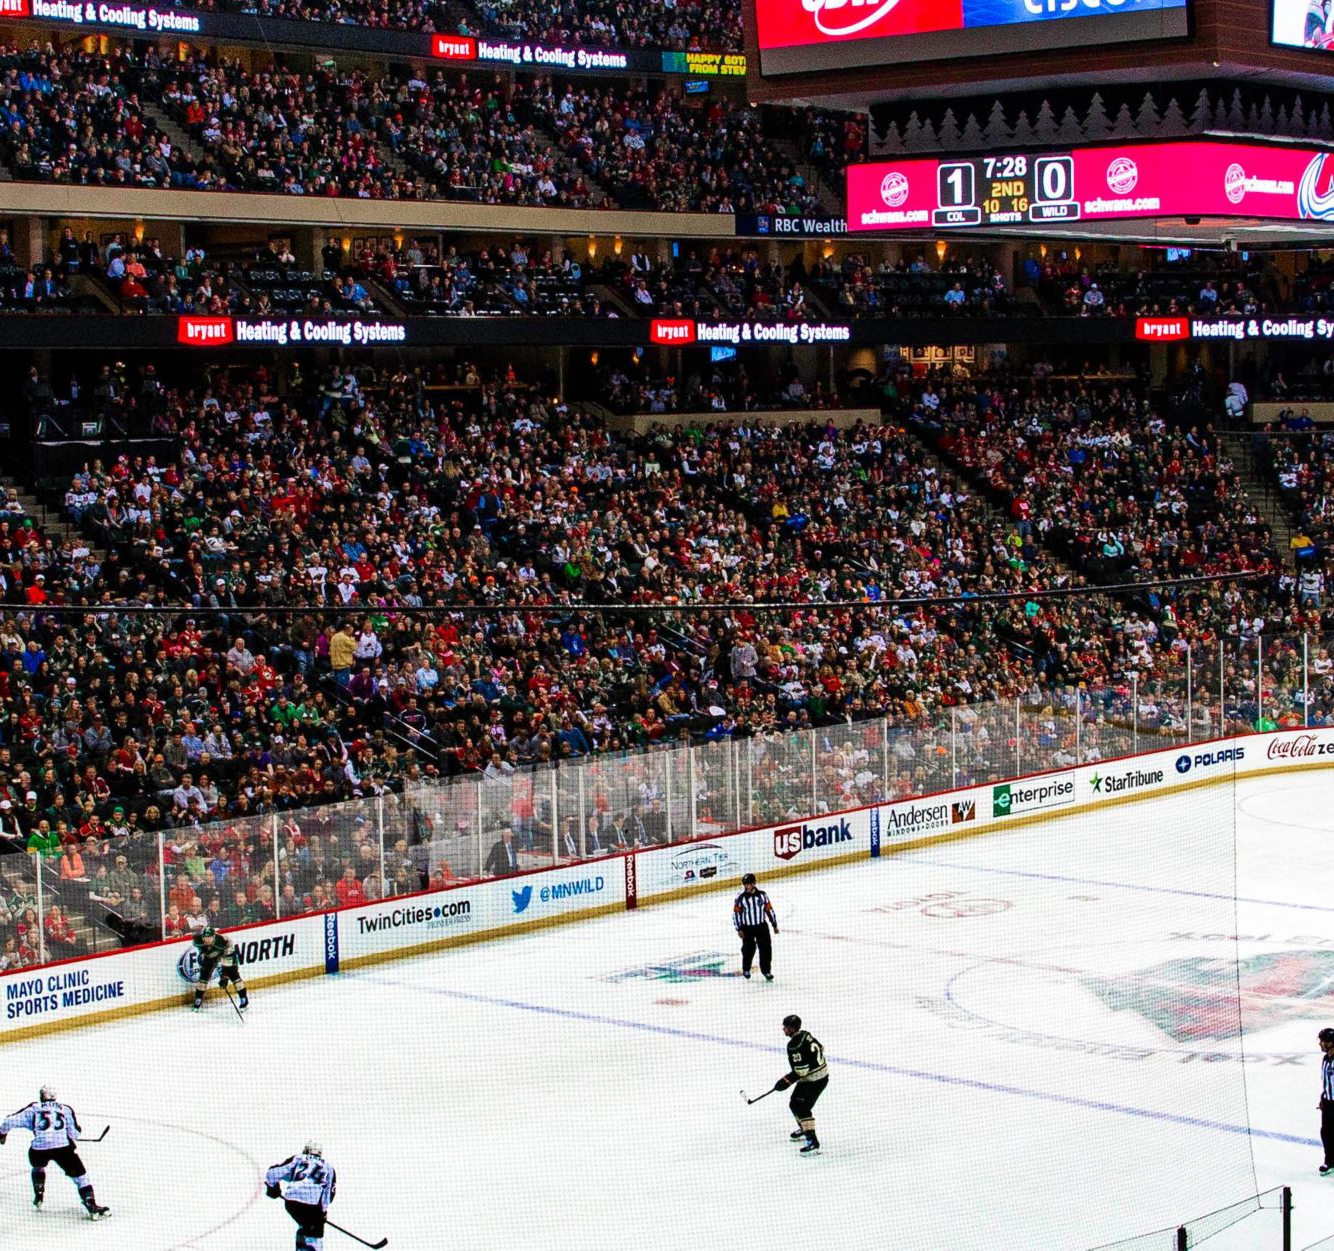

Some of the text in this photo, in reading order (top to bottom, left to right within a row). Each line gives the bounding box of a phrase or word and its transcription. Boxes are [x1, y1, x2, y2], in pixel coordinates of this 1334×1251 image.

[32, 0, 82, 22] Heating
[85, 4, 96, 21] &
[99, 4, 146, 29] Cooling
[148, 10, 199, 31] Systems
[438, 40, 627, 69] bryant Heating & Cooling Systems
[686, 53, 746, 65] HAPPY 60T
[689, 63, 718, 74] FROM
[983, 157, 1027, 179] 7:28
[948, 168, 963, 205] 1
[991, 182, 1024, 197] 2ND
[1042, 162, 1066, 199] 0
[983, 197, 1028, 214] 10 16
[1042, 205, 1067, 218] WILD
[1084, 197, 1160, 214] schwans.com
[775, 218, 799, 232] RBC
[803, 219, 848, 233] Wealth
[861, 210, 929, 225] schwans.com
[947, 212, 965, 223] COL
[990, 212, 1022, 223] SHOTS
[187, 321, 405, 344] bryant Heating & Cooling Systems
[657, 323, 850, 344] bryant Heating & Cooling Systems
[1143, 322, 1181, 337] bryant
[1192, 320, 1245, 339] Heating
[1247, 320, 1259, 336] &
[1262, 319, 1314, 339] Cooling
[1194, 747, 1245, 768] POLARIS
[1105, 770, 1164, 793] StarTribune
[994, 780, 1073, 808] enterprise
[888, 805, 948, 830] Andersen
[625, 855, 634, 897] Reebok
[540, 876, 604, 902] @MNWILD
[326, 913, 336, 960] Reebok
[233, 933, 295, 966] NORTH
[7, 970, 90, 1000] MAYO CLINIC
[7, 981, 124, 1019] SPORTS MEDICINE
[36, 1111, 65, 1131] 55
